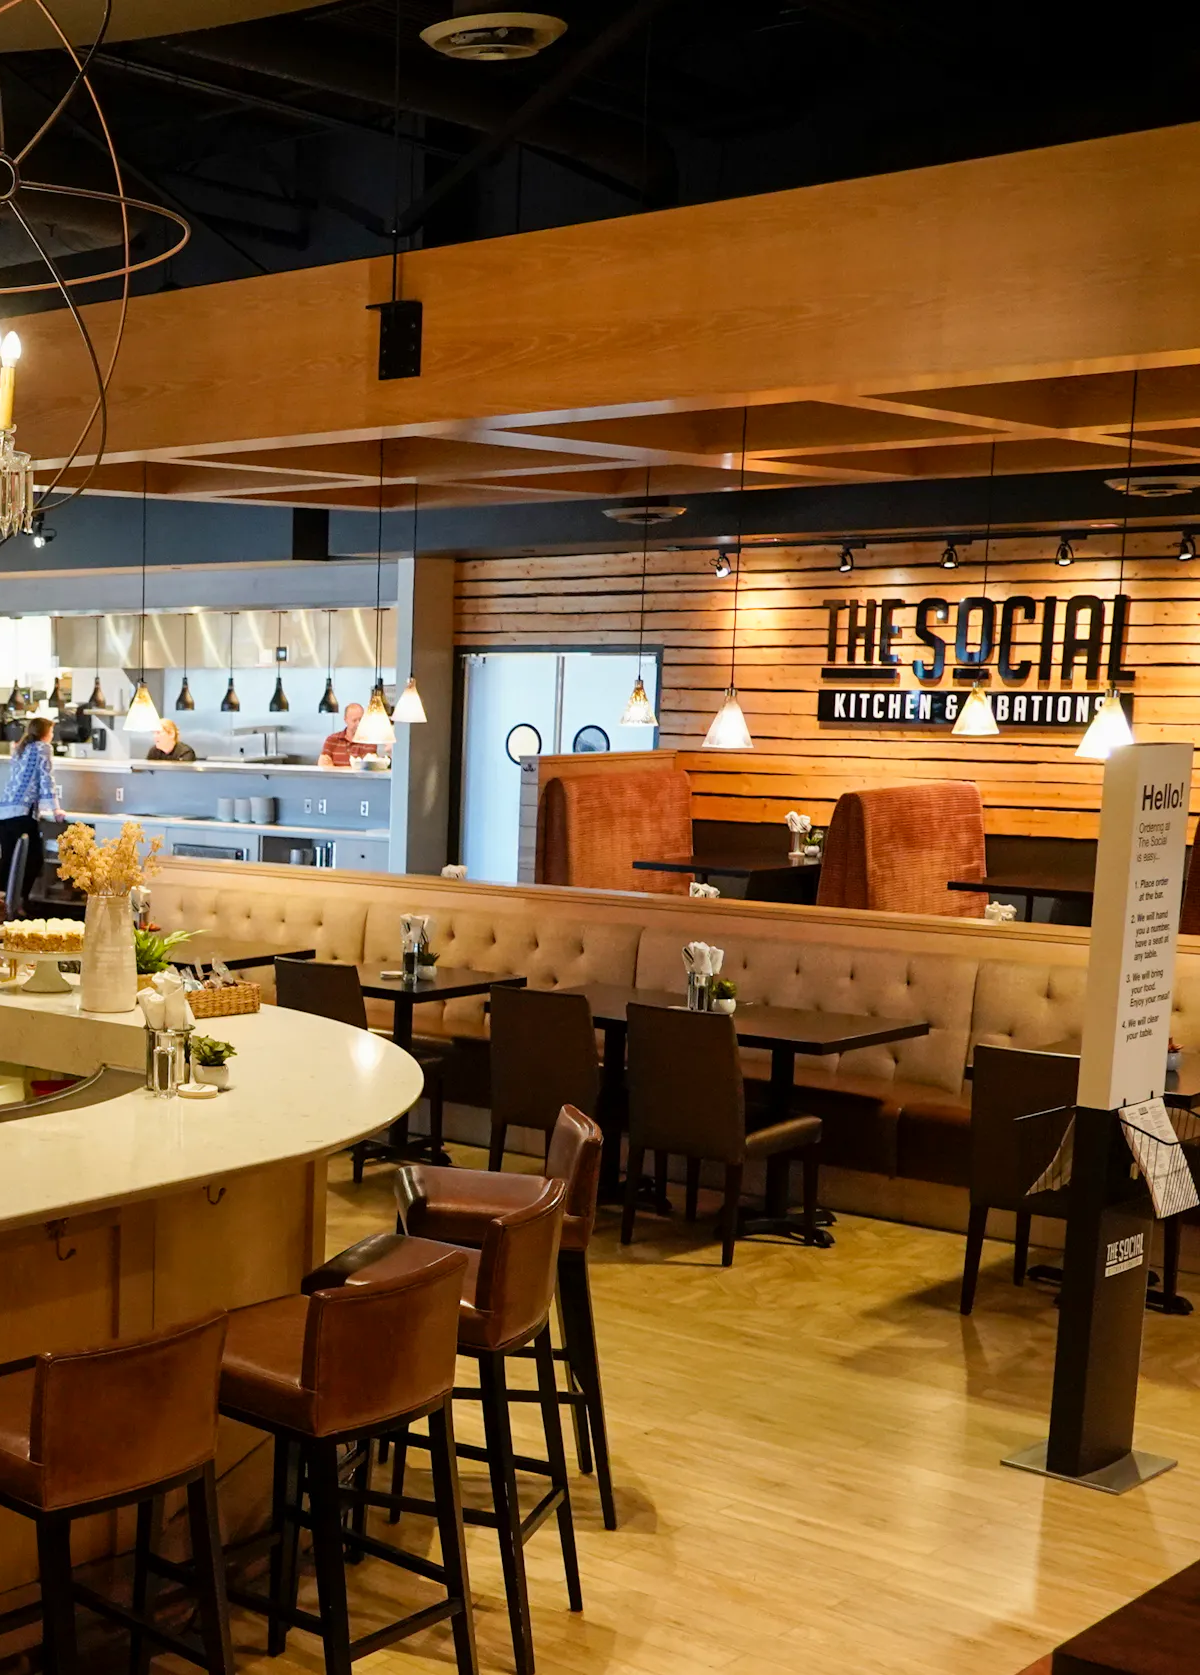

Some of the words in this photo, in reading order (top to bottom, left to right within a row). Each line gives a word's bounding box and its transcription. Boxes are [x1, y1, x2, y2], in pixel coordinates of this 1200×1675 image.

[823, 599, 902, 662] THE
[912, 594, 1136, 682] SOCIAL
[834, 693, 931, 721] KITCHEN
[945, 694, 958, 720] &
[987, 695, 1106, 723] BATION
[1141, 782, 1185, 811] Hello!
[1139, 822, 1164, 834] Ordering
[1138, 837, 1149, 848] The
[1150, 836, 1167, 847] Social
[1140, 879, 1154, 888] Place
[1156, 878, 1169, 887] order
[1139, 893, 1144, 901] at
[1145, 892, 1153, 900] the
[1137, 914, 1145, 922] We
[1146, 912, 1155, 921] will
[1156, 910, 1168, 919] hand
[1136, 927, 1145, 937] you
[1135, 939, 1147, 948] have
[1153, 936, 1163, 945] seat
[1164, 935, 1169, 943] at
[1134, 953, 1143, 962] any
[1132, 973, 1140, 981] We
[1142, 971, 1150, 980] will
[1151, 969, 1164, 978] bring
[1131, 986, 1143, 996] your
[1130, 998, 1144, 1008] Enjoy
[1145, 995, 1156, 1006] your
[1128, 1019, 1136, 1028] We
[1138, 1017, 1146, 1026] will
[1147, 1015, 1159, 1024] clear
[1126, 1032, 1138, 1043] your
[1107, 1241, 1119, 1262] THE
[1119, 1232, 1144, 1262] SOCIAL
